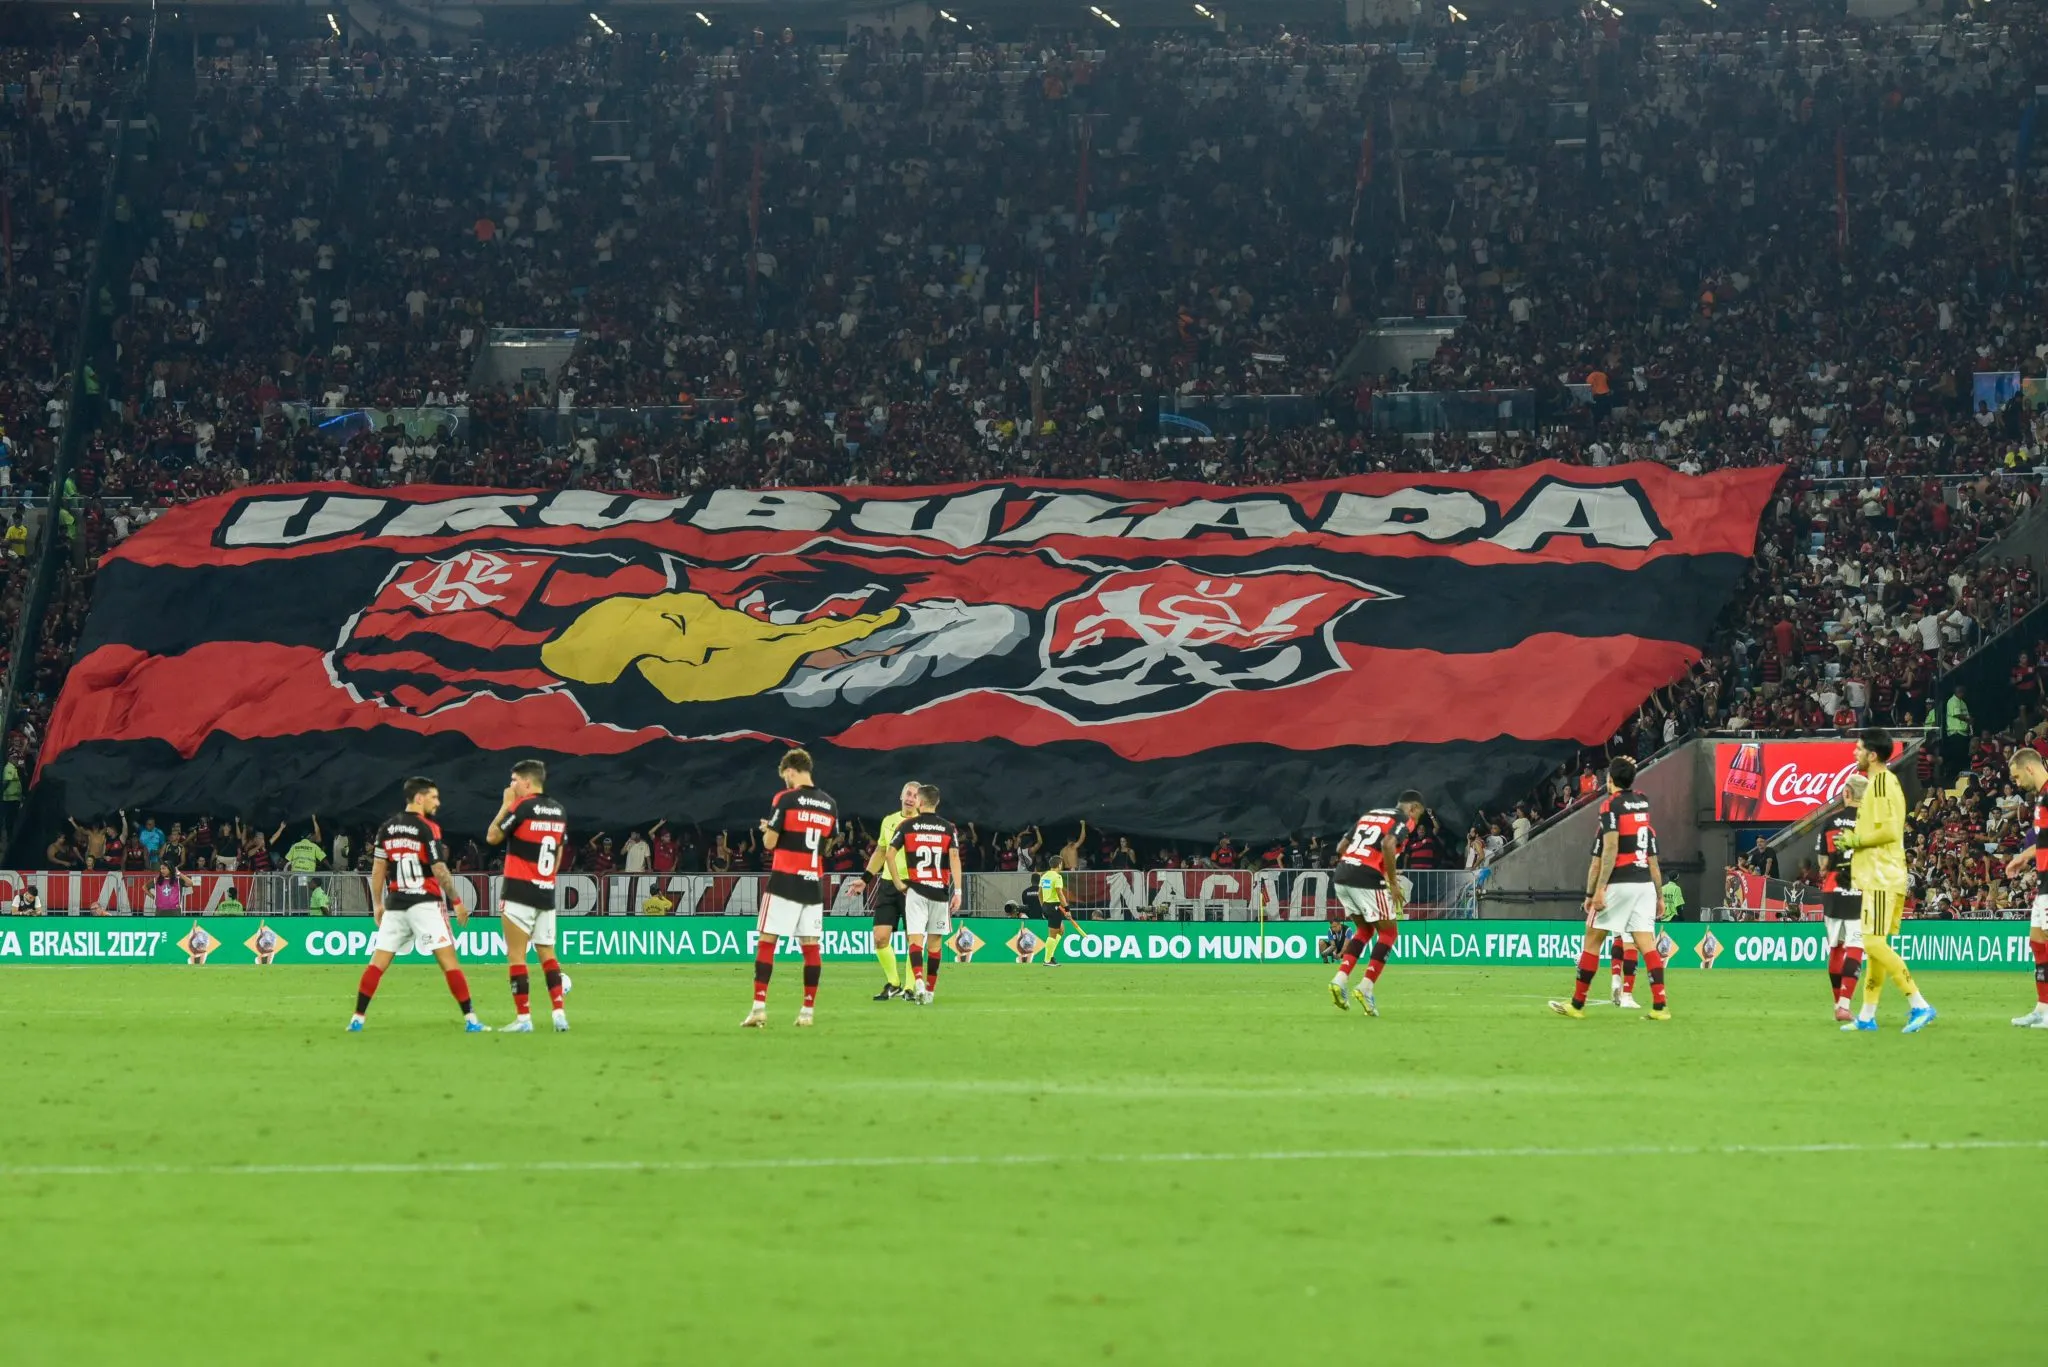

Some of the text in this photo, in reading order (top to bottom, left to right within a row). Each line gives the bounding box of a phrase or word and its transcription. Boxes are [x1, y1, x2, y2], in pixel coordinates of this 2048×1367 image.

[537, 835, 556, 876] 6
[805, 827, 822, 868] 4
[1346, 824, 1381, 857] 52
[391, 852, 426, 890] 10
[916, 845, 943, 879] 21
[30, 931, 105, 956] BRASIL
[562, 930, 694, 955] FEMININA
[702, 930, 739, 955] DA
[1063, 934, 1142, 959] COPA
[1159, 935, 1191, 959] DO
[1199, 935, 1307, 959] MUNDO
[1451, 934, 1480, 958] DA
[1486, 934, 1532, 958] FIFA
[1735, 936, 1794, 962] COPA
[1795, 936, 1818, 962] DO
[1978, 935, 2002, 962] DA
